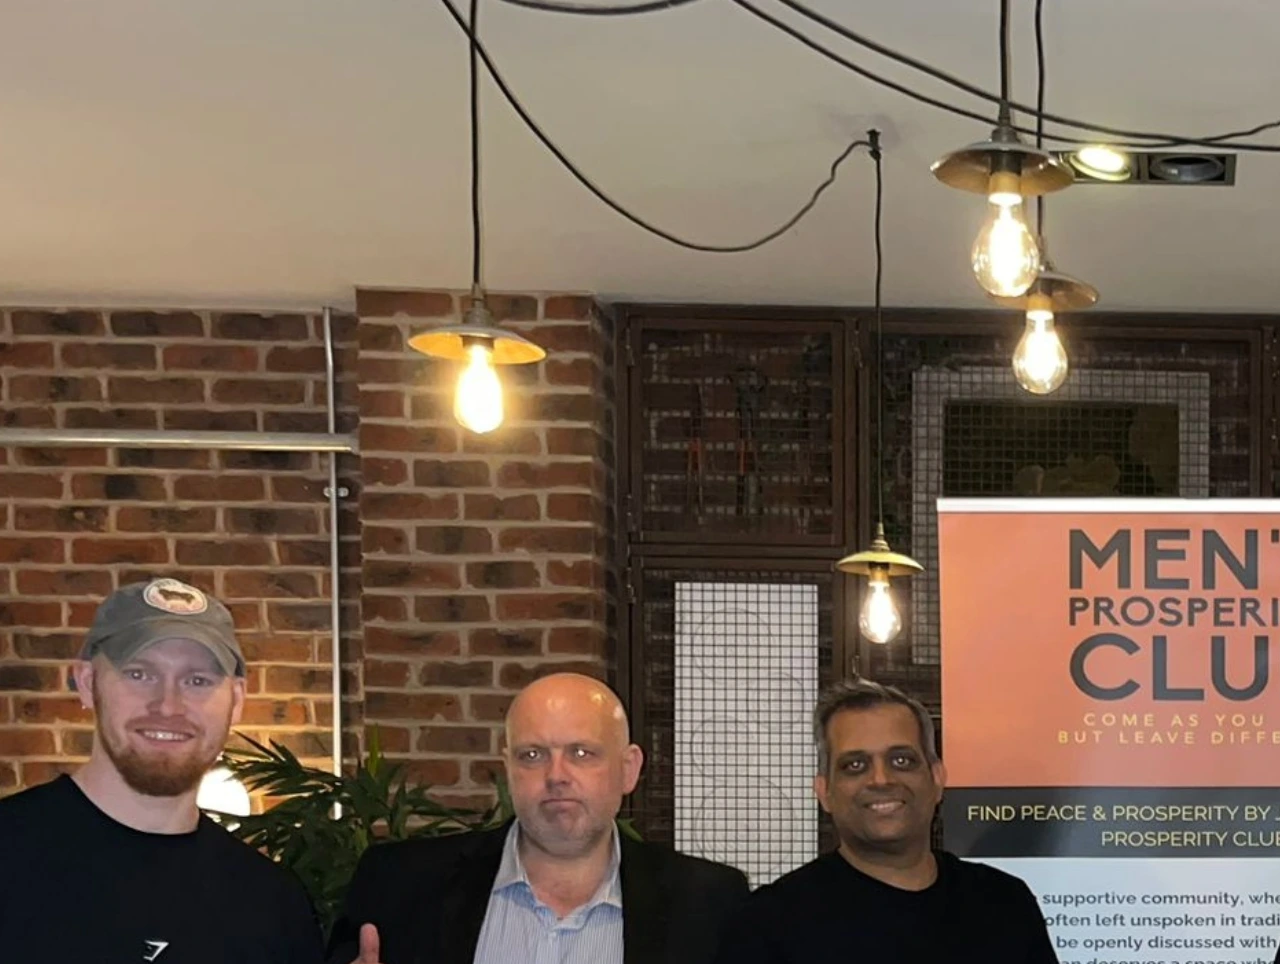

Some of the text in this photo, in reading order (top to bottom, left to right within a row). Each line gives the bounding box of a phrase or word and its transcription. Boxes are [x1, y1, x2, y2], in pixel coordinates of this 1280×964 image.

[1084, 714, 1156, 727] COME
[1172, 714, 1200, 727] AS
[1216, 714, 1264, 727] YOU
[1058, 731, 1103, 745] BUT
[1120, 731, 1196, 744] LEAVE
[968, 805, 1016, 821] FIND
[1021, 805, 1087, 821] PEACE
[1092, 804, 1107, 821] &
[1112, 805, 1239, 821] PROSPERITY
[1244, 805, 1271, 821] BY
[1101, 831, 1228, 847] PROSPERITY
[1042, 892, 1137, 908] supportive
[1141, 892, 1244, 908] community,
[1044, 914, 1091, 926] often
[1096, 914, 1126, 926] left
[1130, 914, 1216, 930] unspoken
[1221, 914, 1236, 926] in
[1056, 936, 1278, 952] be openly discussed with
